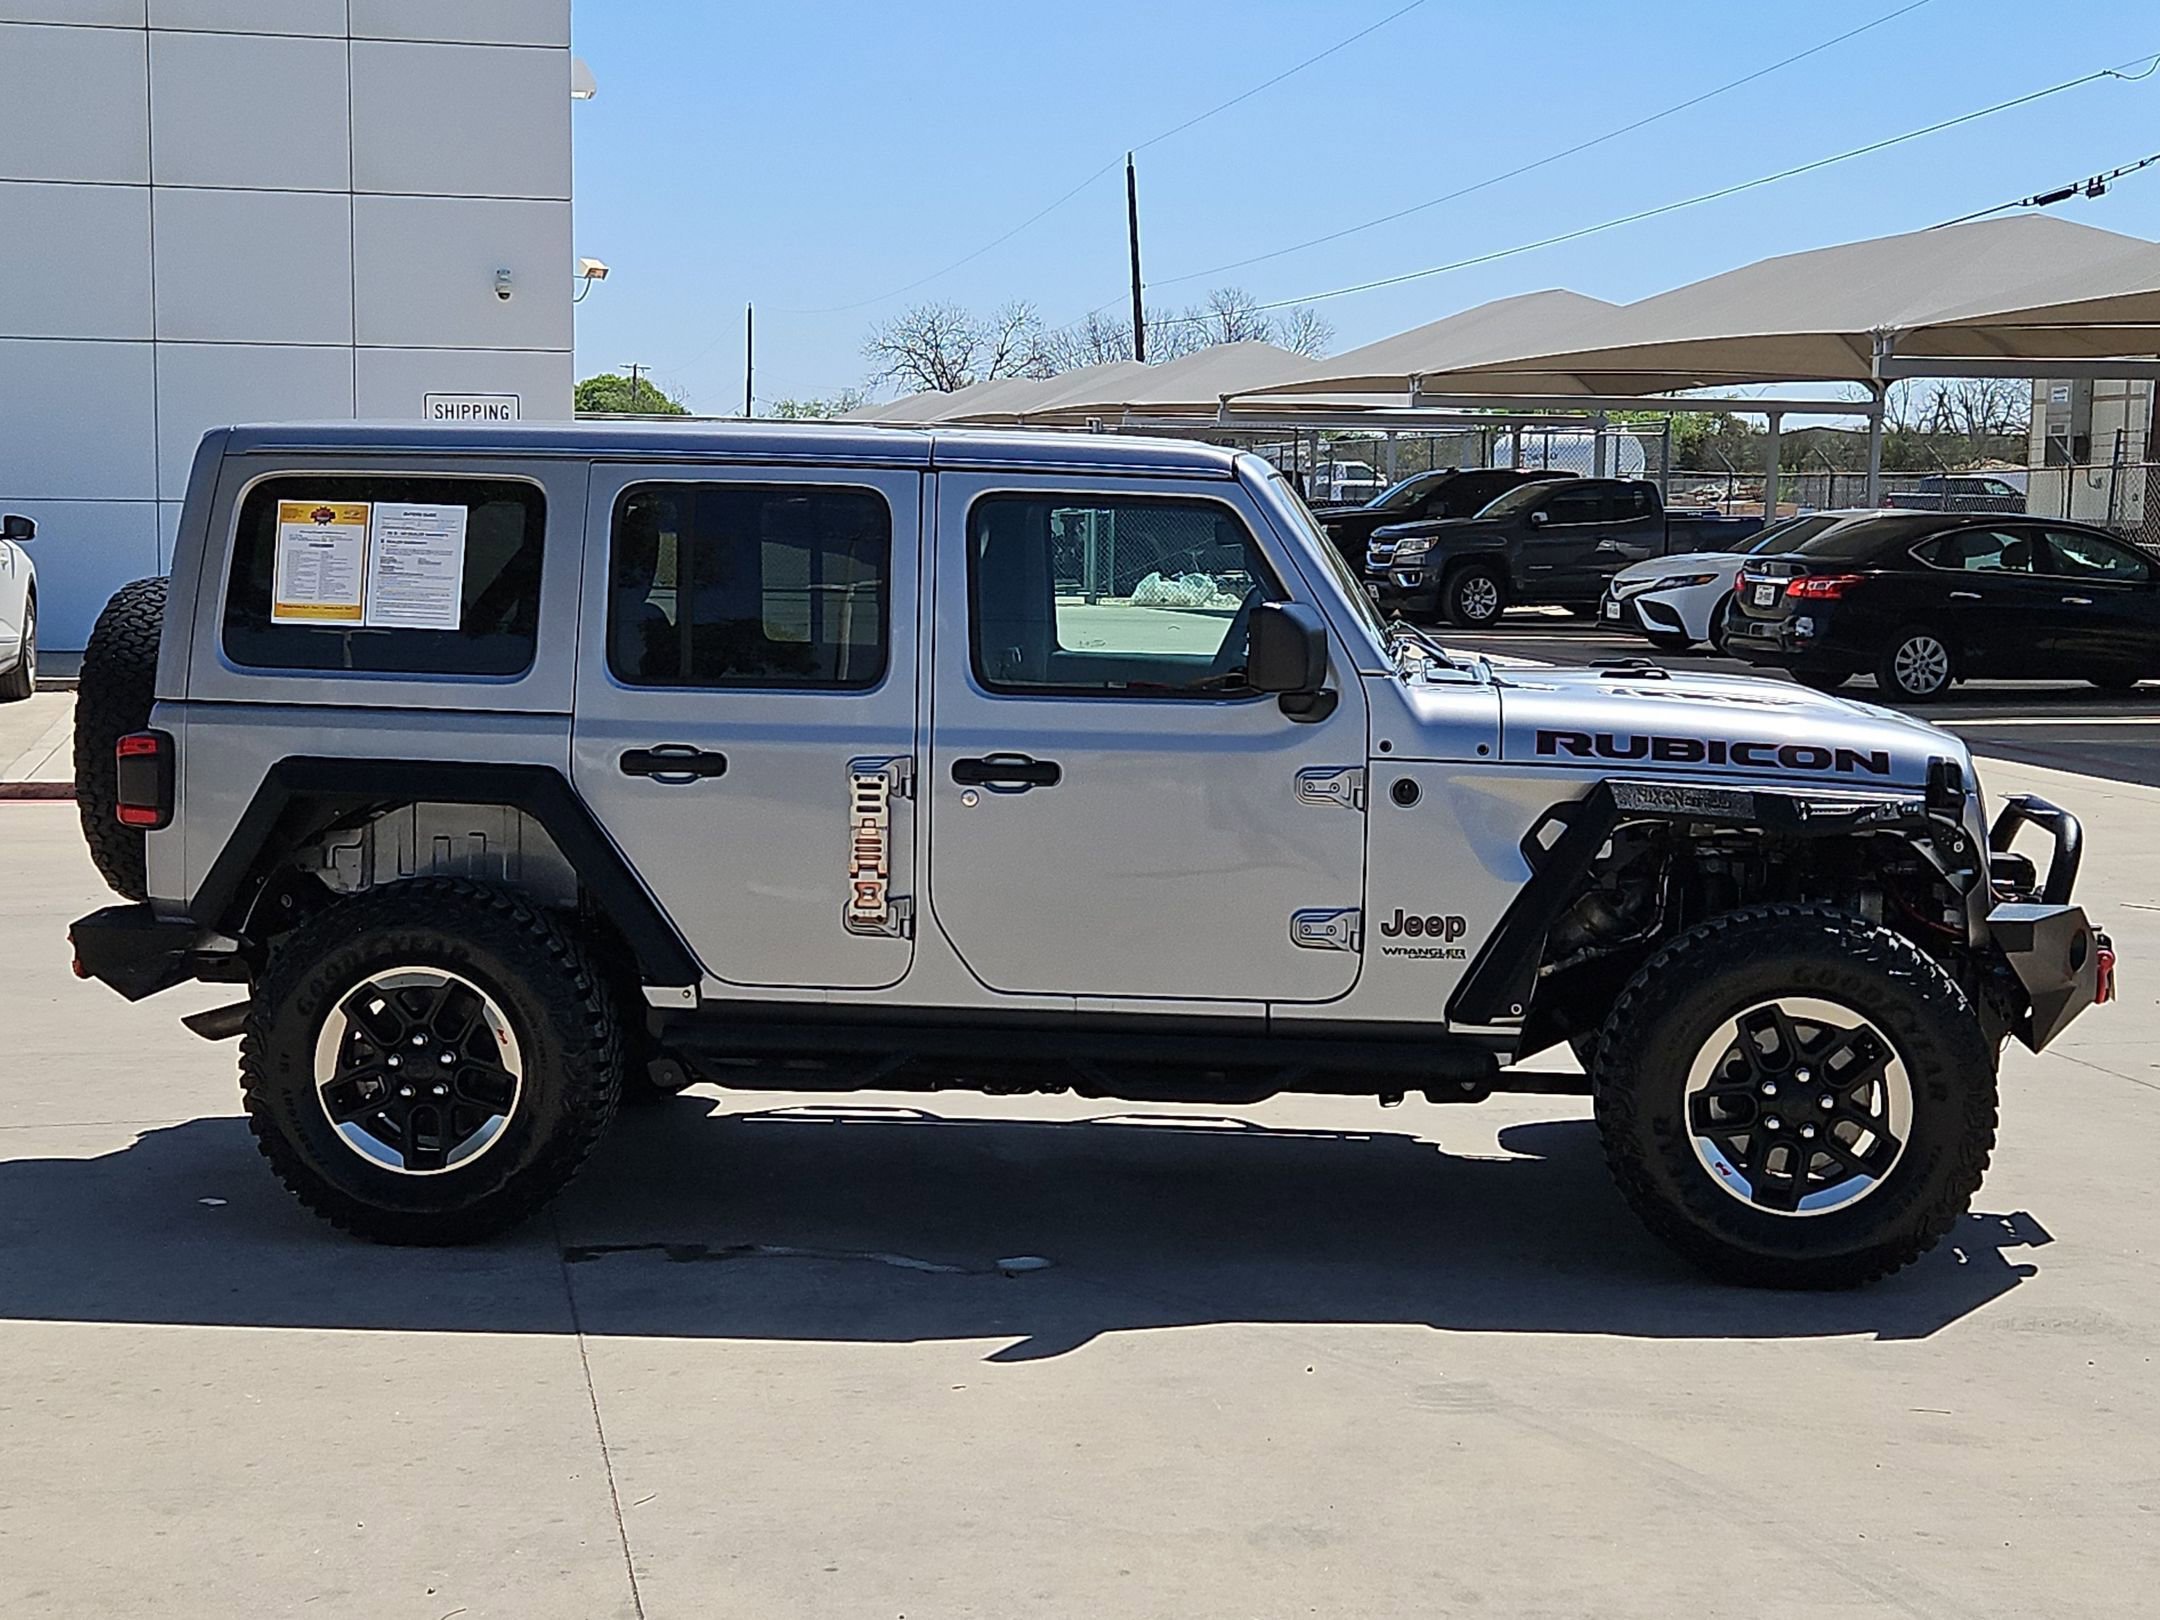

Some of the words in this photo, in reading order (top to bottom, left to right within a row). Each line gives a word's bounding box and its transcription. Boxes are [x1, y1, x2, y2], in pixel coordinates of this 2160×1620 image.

[434, 403, 510, 420] SHIPPING
[1535, 730, 1891, 775] RUBICON
[1380, 908, 1467, 943] Jeep
[1382, 946, 1466, 957] WRANGLER
